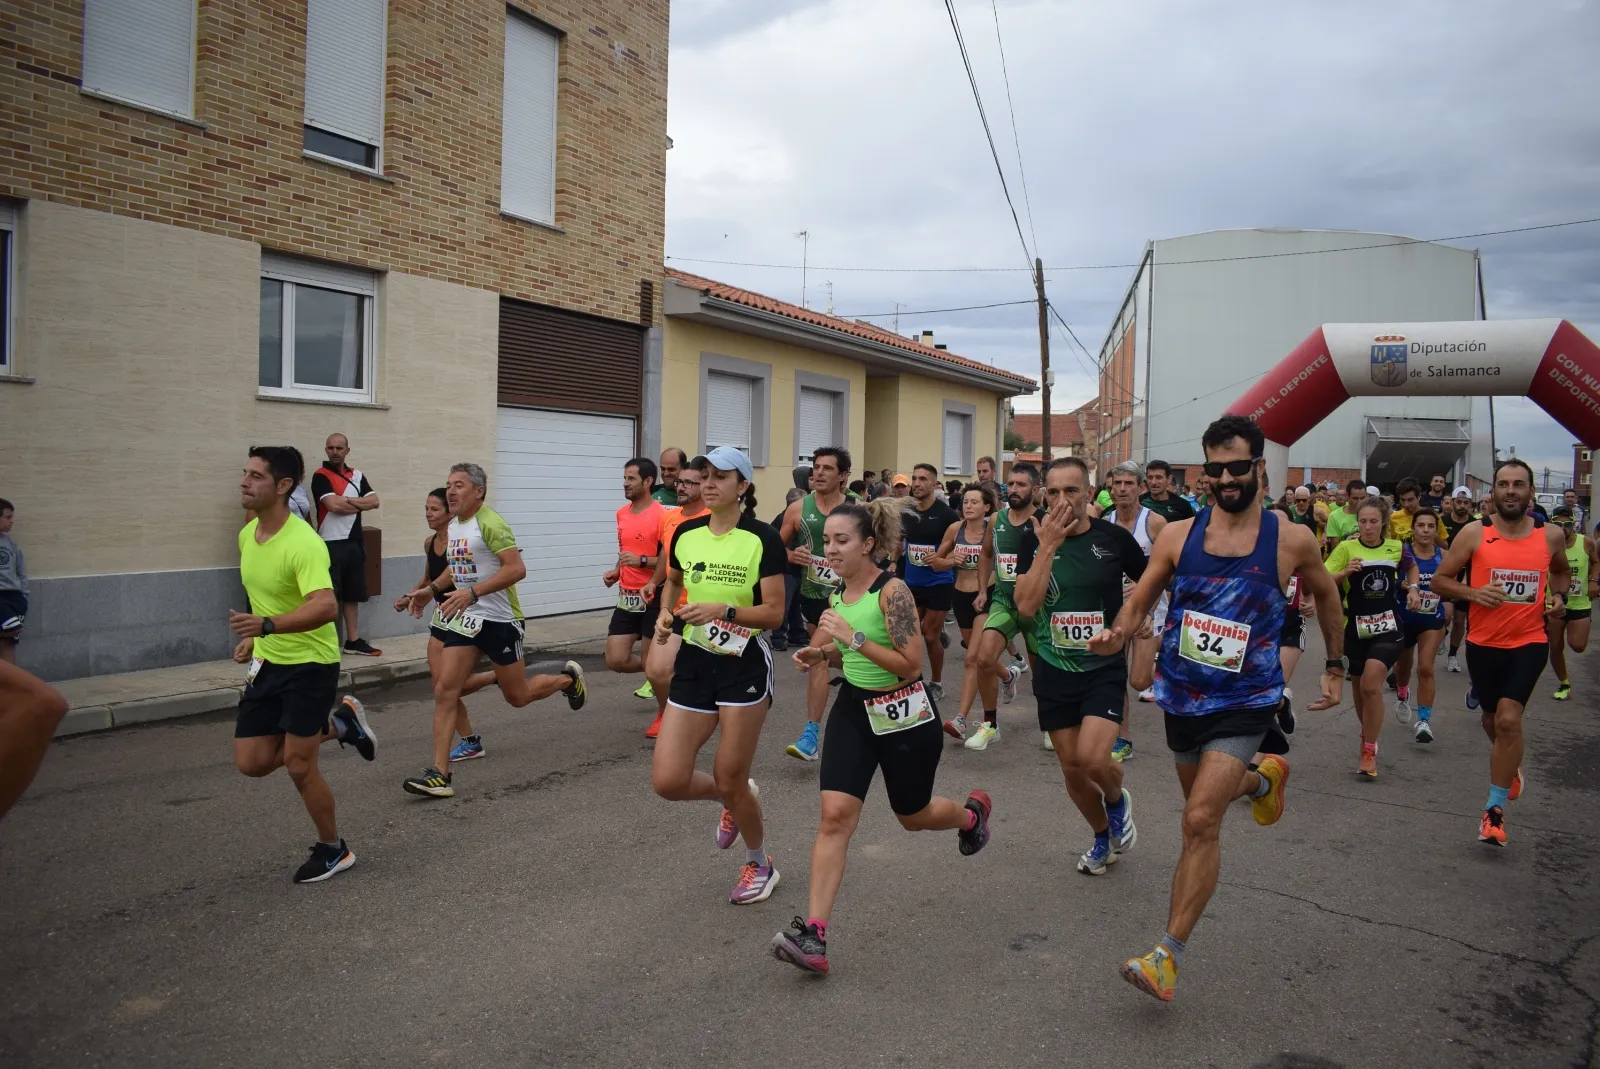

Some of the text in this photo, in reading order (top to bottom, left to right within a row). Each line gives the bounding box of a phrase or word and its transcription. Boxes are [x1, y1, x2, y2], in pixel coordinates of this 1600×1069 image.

[1410, 340, 1487, 356] Diputación
[1410, 364, 1501, 378] de Salamanca
[1556, 353, 1583, 376] CON
[1248, 354, 1328, 422] ON EL DEPORTE
[956, 545, 981, 554] beduni
[709, 562, 748, 572] BALNEARIO
[714, 569, 747, 578] LEDESMA
[817, 566, 831, 580] 74
[705, 575, 746, 584] MONTEPIO
[1491, 571, 1539, 583] bedunia
[1505, 582, 1525, 596] 70
[460, 615, 476, 630] 126
[1052, 614, 1103, 625] bedunia
[1061, 625, 1094, 640] 103
[1183, 612, 1249, 642] bedunia
[1365, 620, 1390, 634] 122
[708, 626, 731, 646] 99
[1196, 632, 1224, 656] 34
[885, 698, 910, 721] 87
